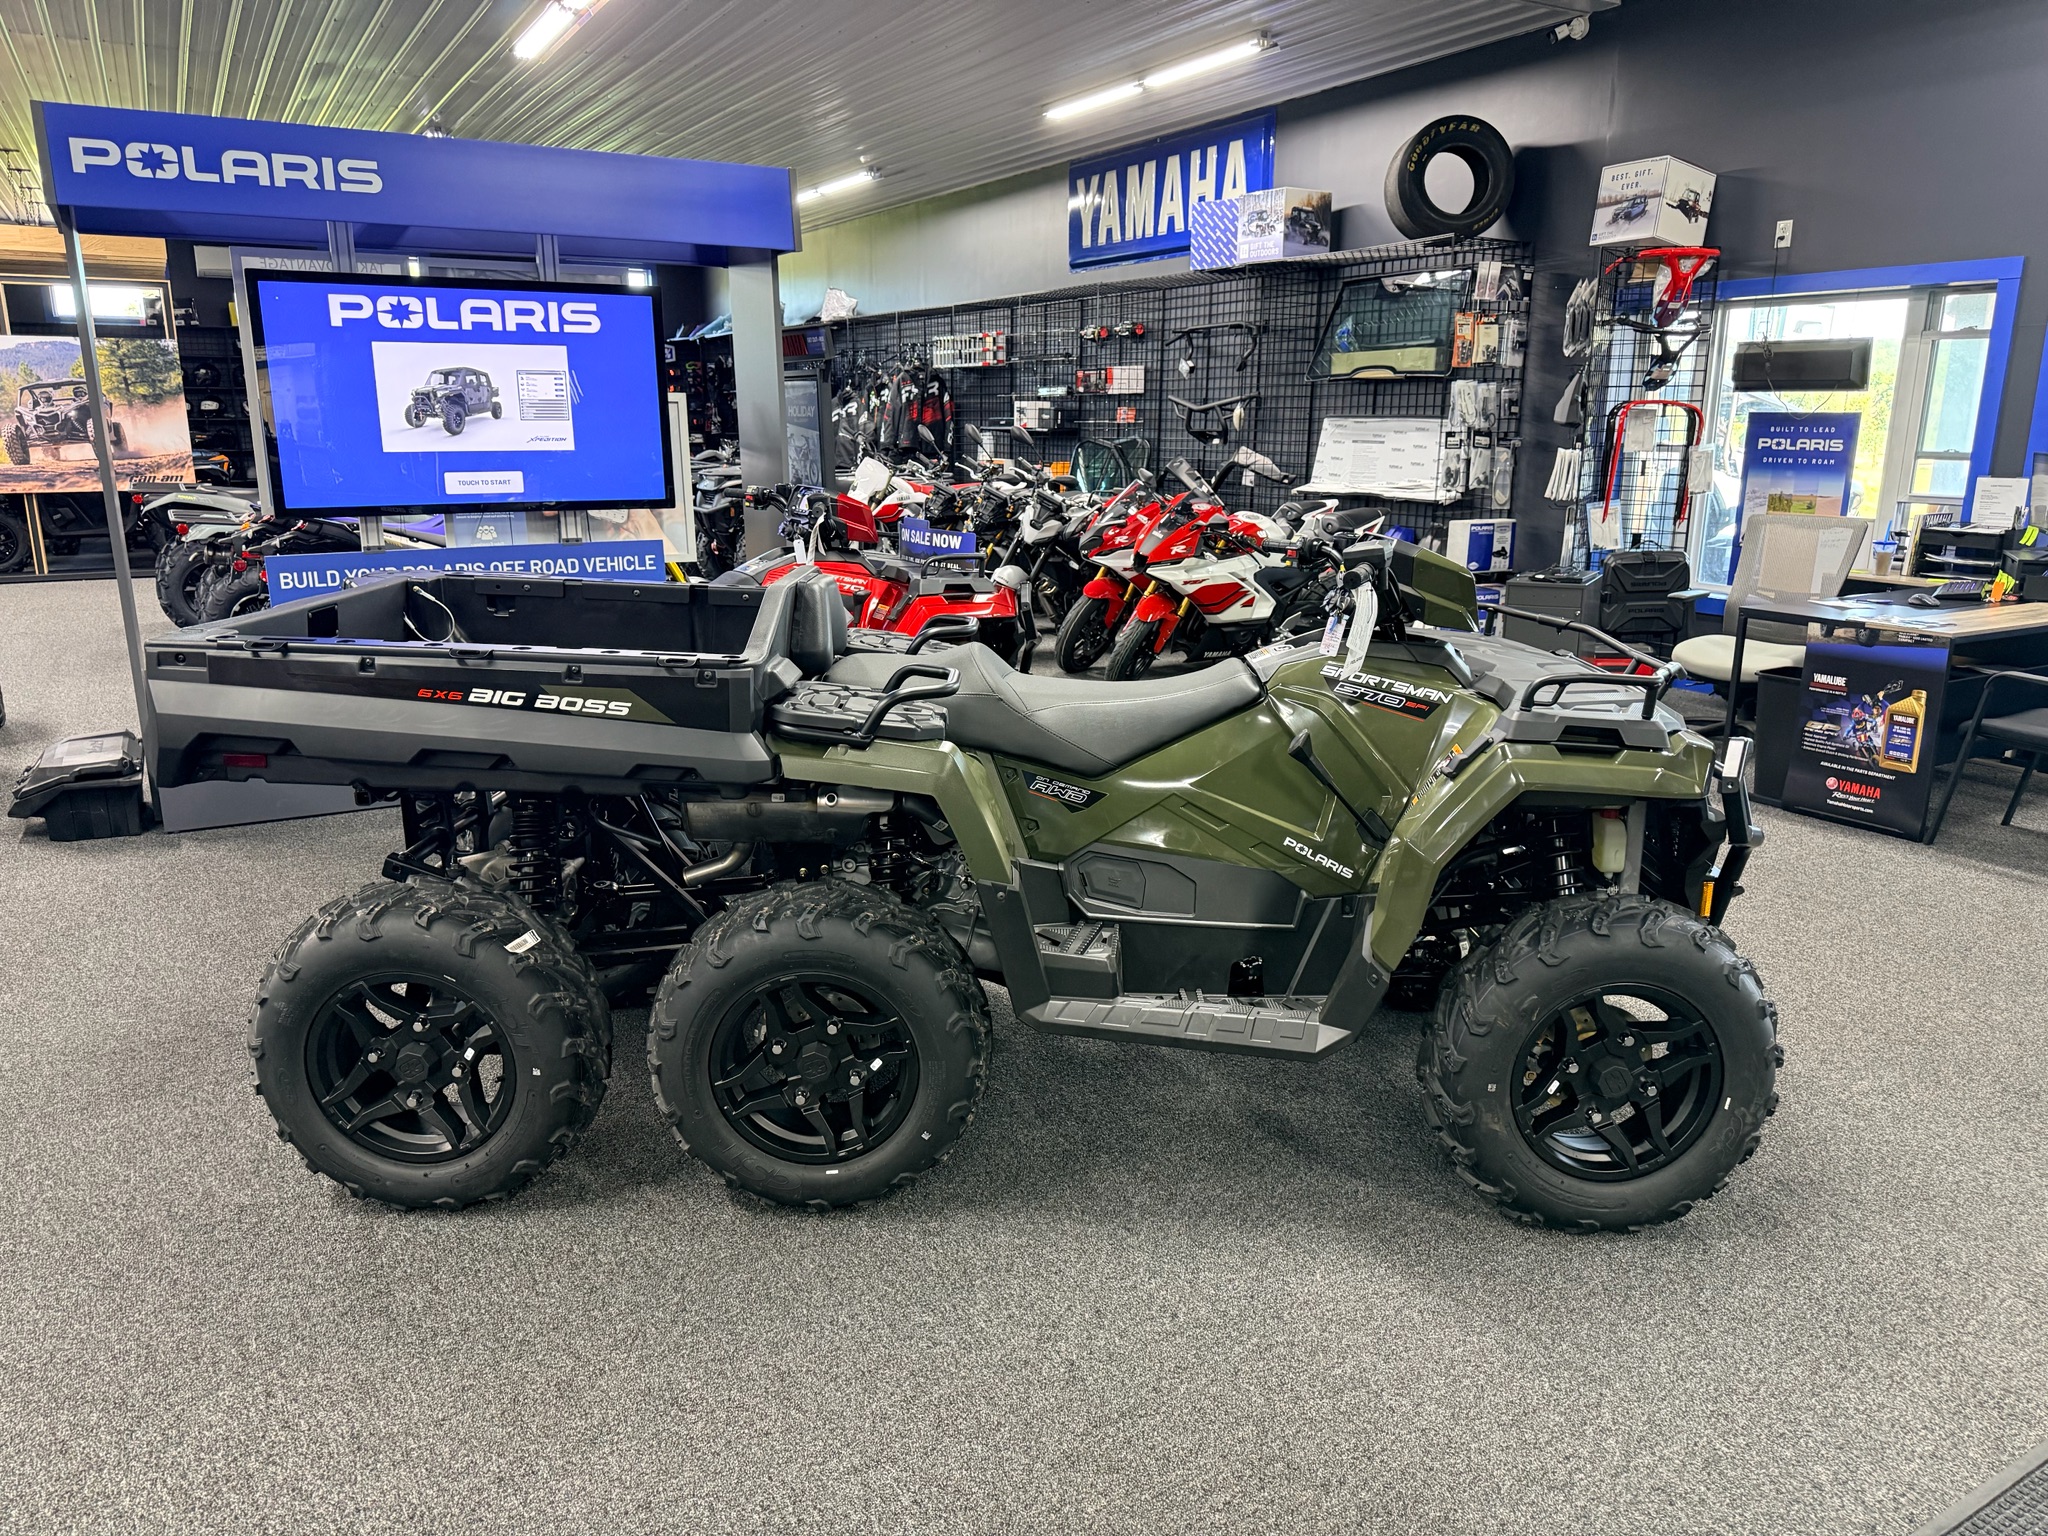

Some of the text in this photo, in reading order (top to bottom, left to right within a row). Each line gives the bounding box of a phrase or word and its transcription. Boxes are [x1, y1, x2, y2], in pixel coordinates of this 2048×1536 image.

[1407, 122, 1480, 171] GOODYEAR
[68, 136, 384, 194] POLARIS
[1611, 168, 1654, 182] BEST. GIFT.
[1076, 138, 1247, 249] YAMAHA
[1621, 181, 1642, 190] EVER.
[1249, 247, 1280, 258] OUTDOORS
[1250, 239, 1276, 250] GIFT THE
[327, 293, 602, 334] POLARIS
[787, 404, 816, 419] HOLIDAY
[1757, 437, 1844, 452] POLARIS
[1762, 456, 1794, 464] DRIVEN
[457, 479, 480, 487] TOUCH
[901, 528, 963, 550] ON SALE NOW
[278, 569, 342, 590] BUILD
[344, 566, 397, 582] YO
[530, 558, 580, 575] ROAD
[583, 554, 657, 573] VEHICLE
[1203, 651, 1232, 659] YAMAHA
[1813, 672, 1846, 687] YAMALUBE
[417, 687, 633, 716] 6X6 BIG BOSS
[1333, 681, 1406, 708] 570
[1893, 714, 1915, 724] YAMALUBE
[1820, 761, 1841, 769] AVAILABLE
[1867, 770, 1896, 781] DEPARTMENT
[1029, 780, 1088, 804] AWD
[1035, 775, 1091, 795] ON DEMAND
[1838, 779, 1881, 799] YAMAHA
[1282, 836, 1354, 879] POLARIS
